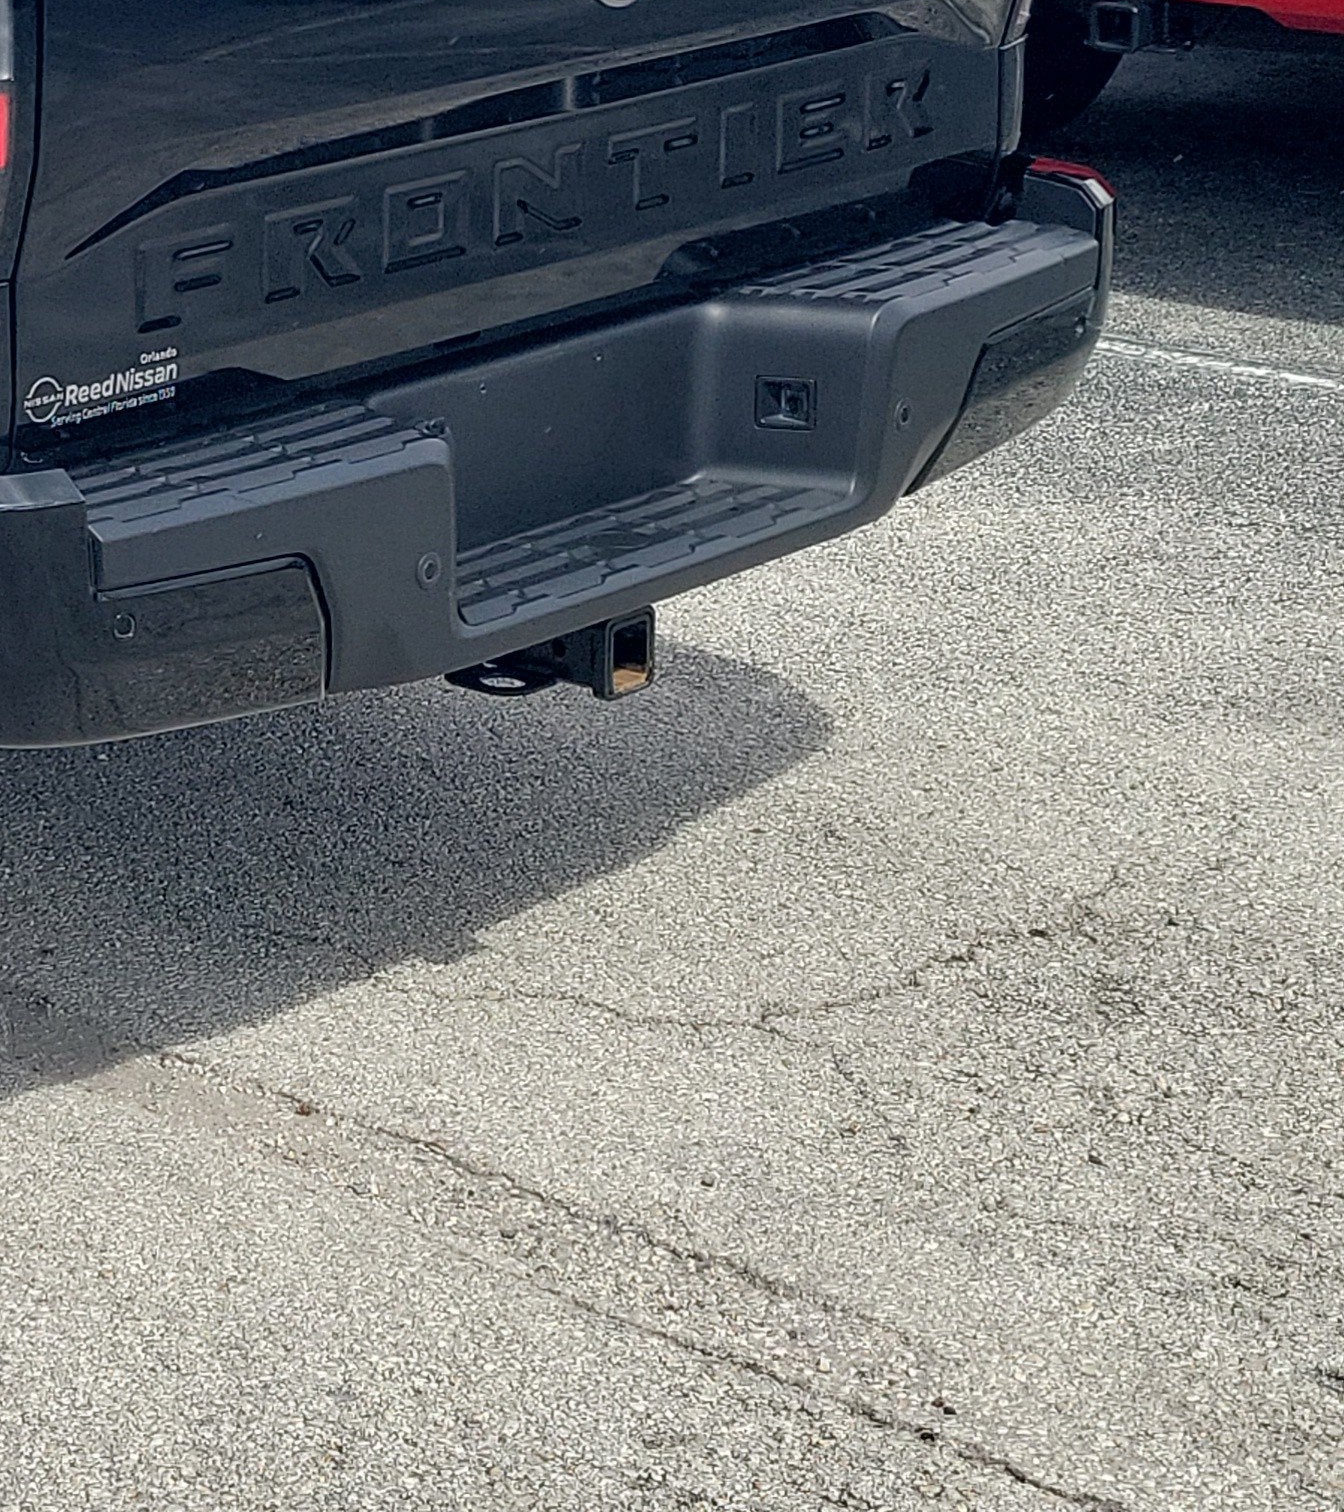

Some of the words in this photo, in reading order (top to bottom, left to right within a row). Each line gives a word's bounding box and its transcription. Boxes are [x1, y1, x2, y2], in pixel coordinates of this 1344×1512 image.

[135, 68, 934, 334] FRONTIER
[140, 347, 177, 364] Orlando
[23, 392, 64, 409] NISSAN
[50, 410, 82, 428] Serving
[82, 401, 111, 420] Central
[111, 395, 138, 412] Florida
[138, 392, 158, 406] since
